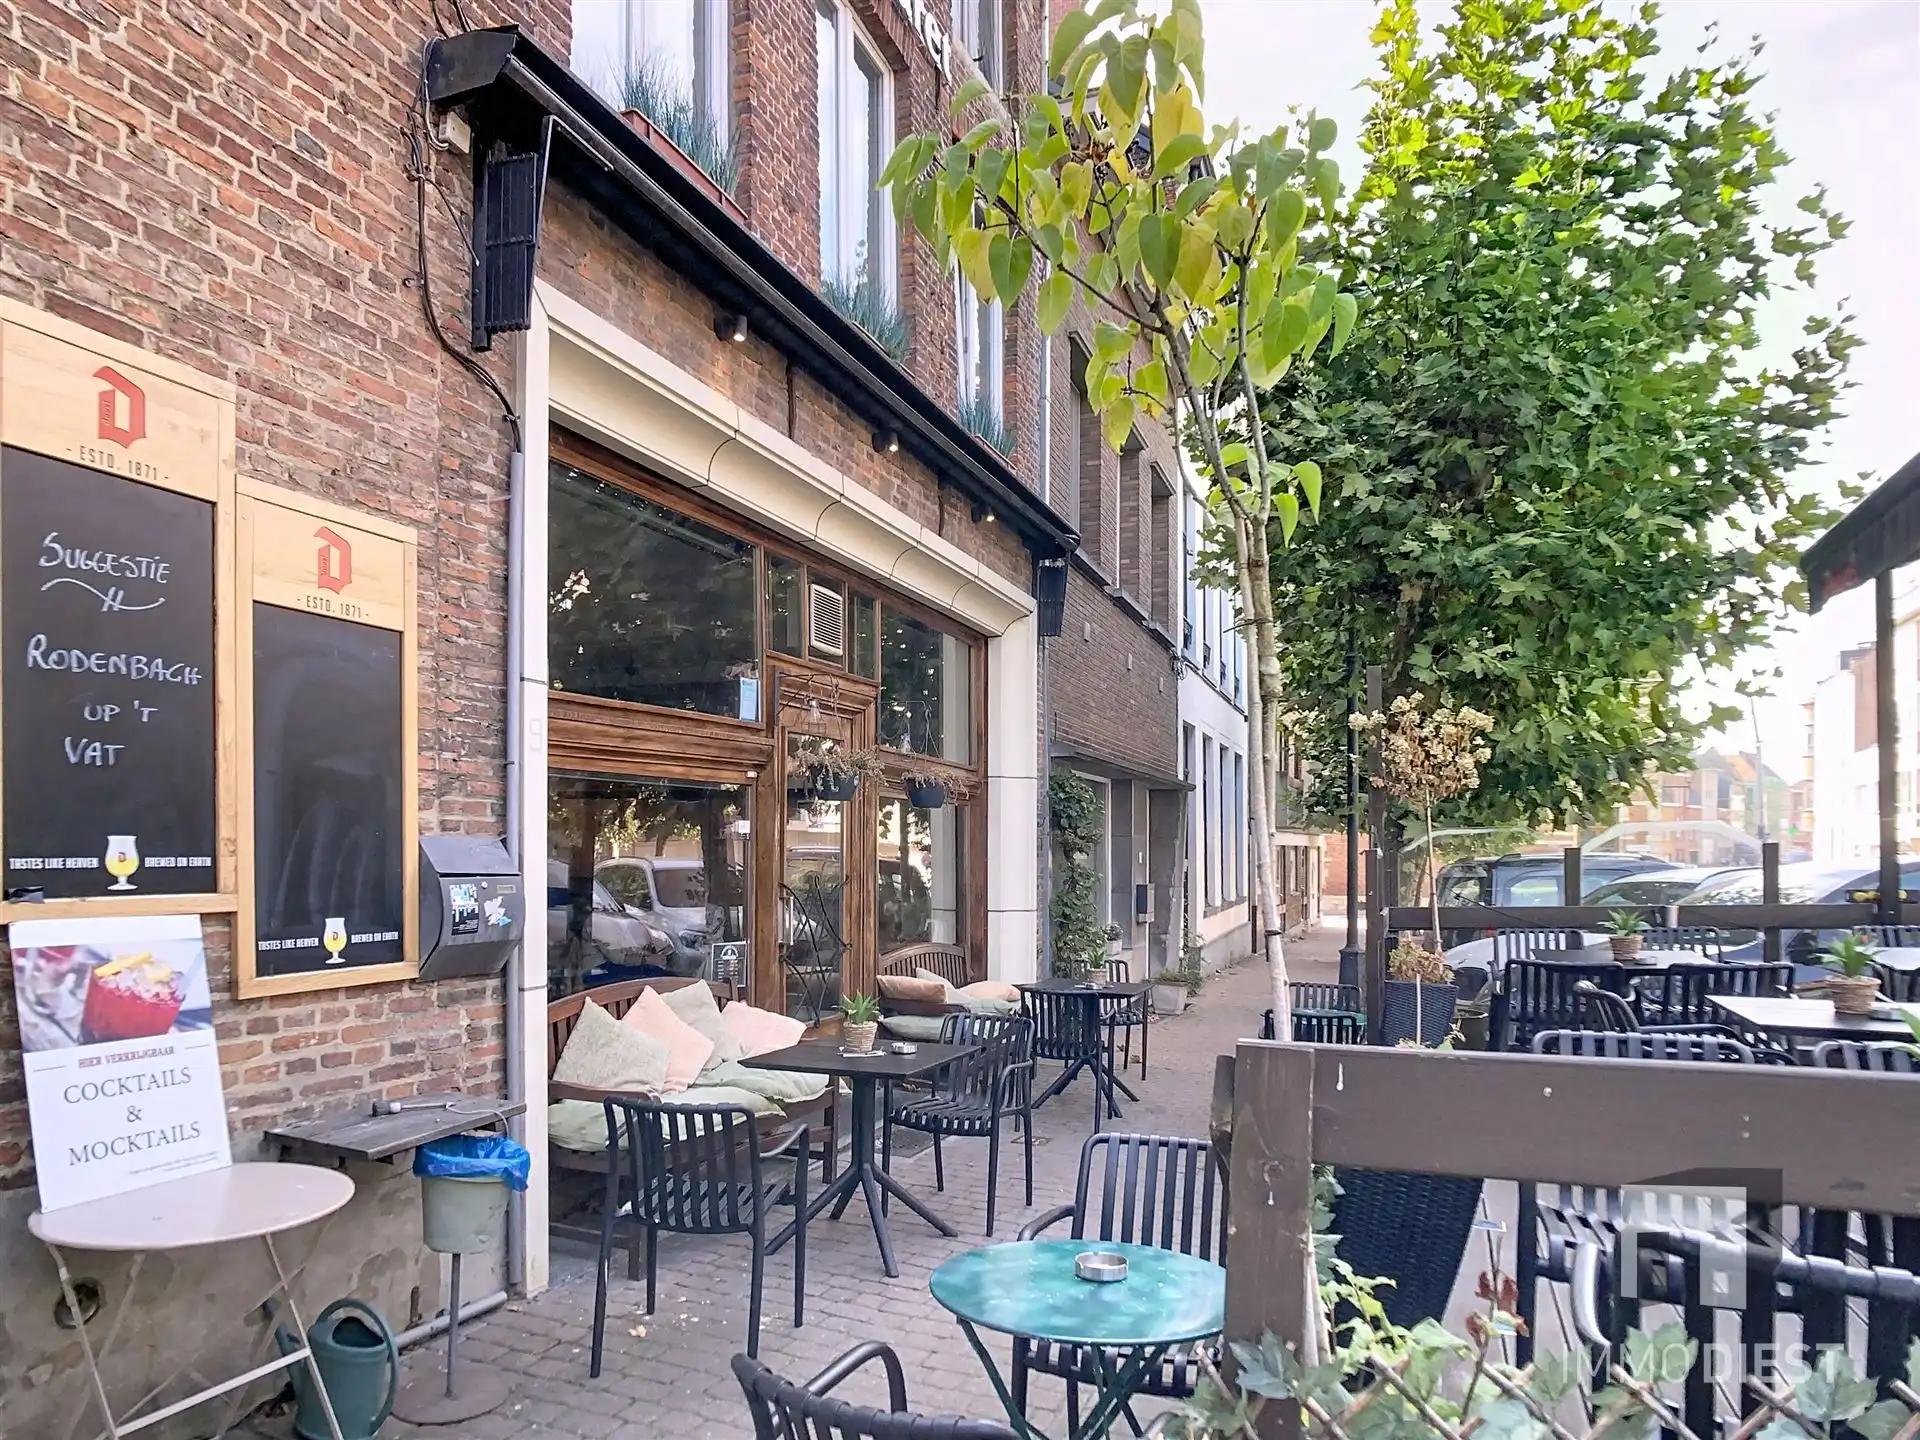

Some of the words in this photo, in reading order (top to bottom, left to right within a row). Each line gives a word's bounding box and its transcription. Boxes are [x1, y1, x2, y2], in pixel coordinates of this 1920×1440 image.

[80, 445, 121, 471] ESTD.
[128, 460, 157, 480] 1871
[306, 595, 335, 614] ESTD.
[340, 603, 361, 618] 1871
[84, 703, 121, 722] UP
[64, 736, 125, 766] VAT
[9, 857, 44, 870] TASTES
[45, 857, 65, 869] LIKE
[63, 1066, 193, 1105] COCKTAILS
[126, 1105, 143, 1123] &
[68, 1121, 202, 1166] MOCKTAILS
